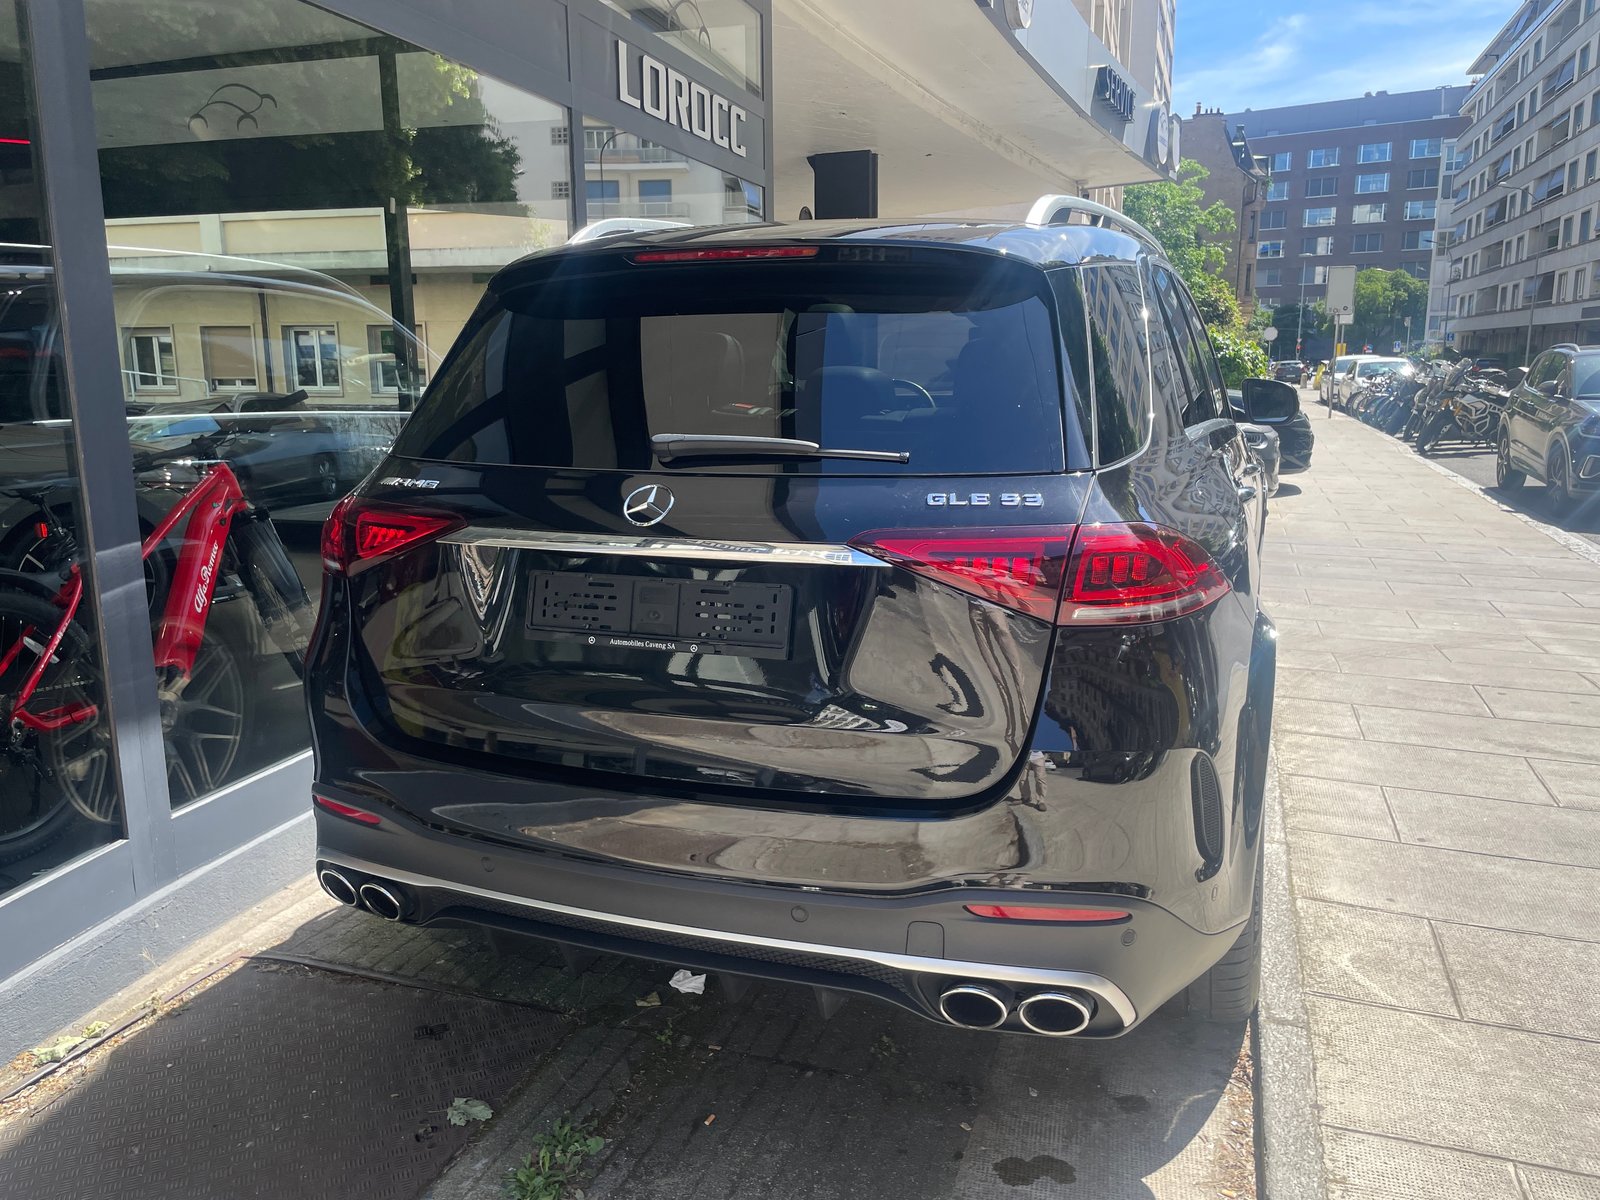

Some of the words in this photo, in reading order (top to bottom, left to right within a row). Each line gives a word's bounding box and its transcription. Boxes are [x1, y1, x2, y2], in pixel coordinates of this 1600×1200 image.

[616, 38, 747, 158] LOROCC
[926, 492, 991, 506] GLE
[1000, 492, 1044, 507] 53
[610, 638, 645, 647] Automobiles
[645, 641, 667, 650] Caveng
[667, 642, 676, 650] SA
